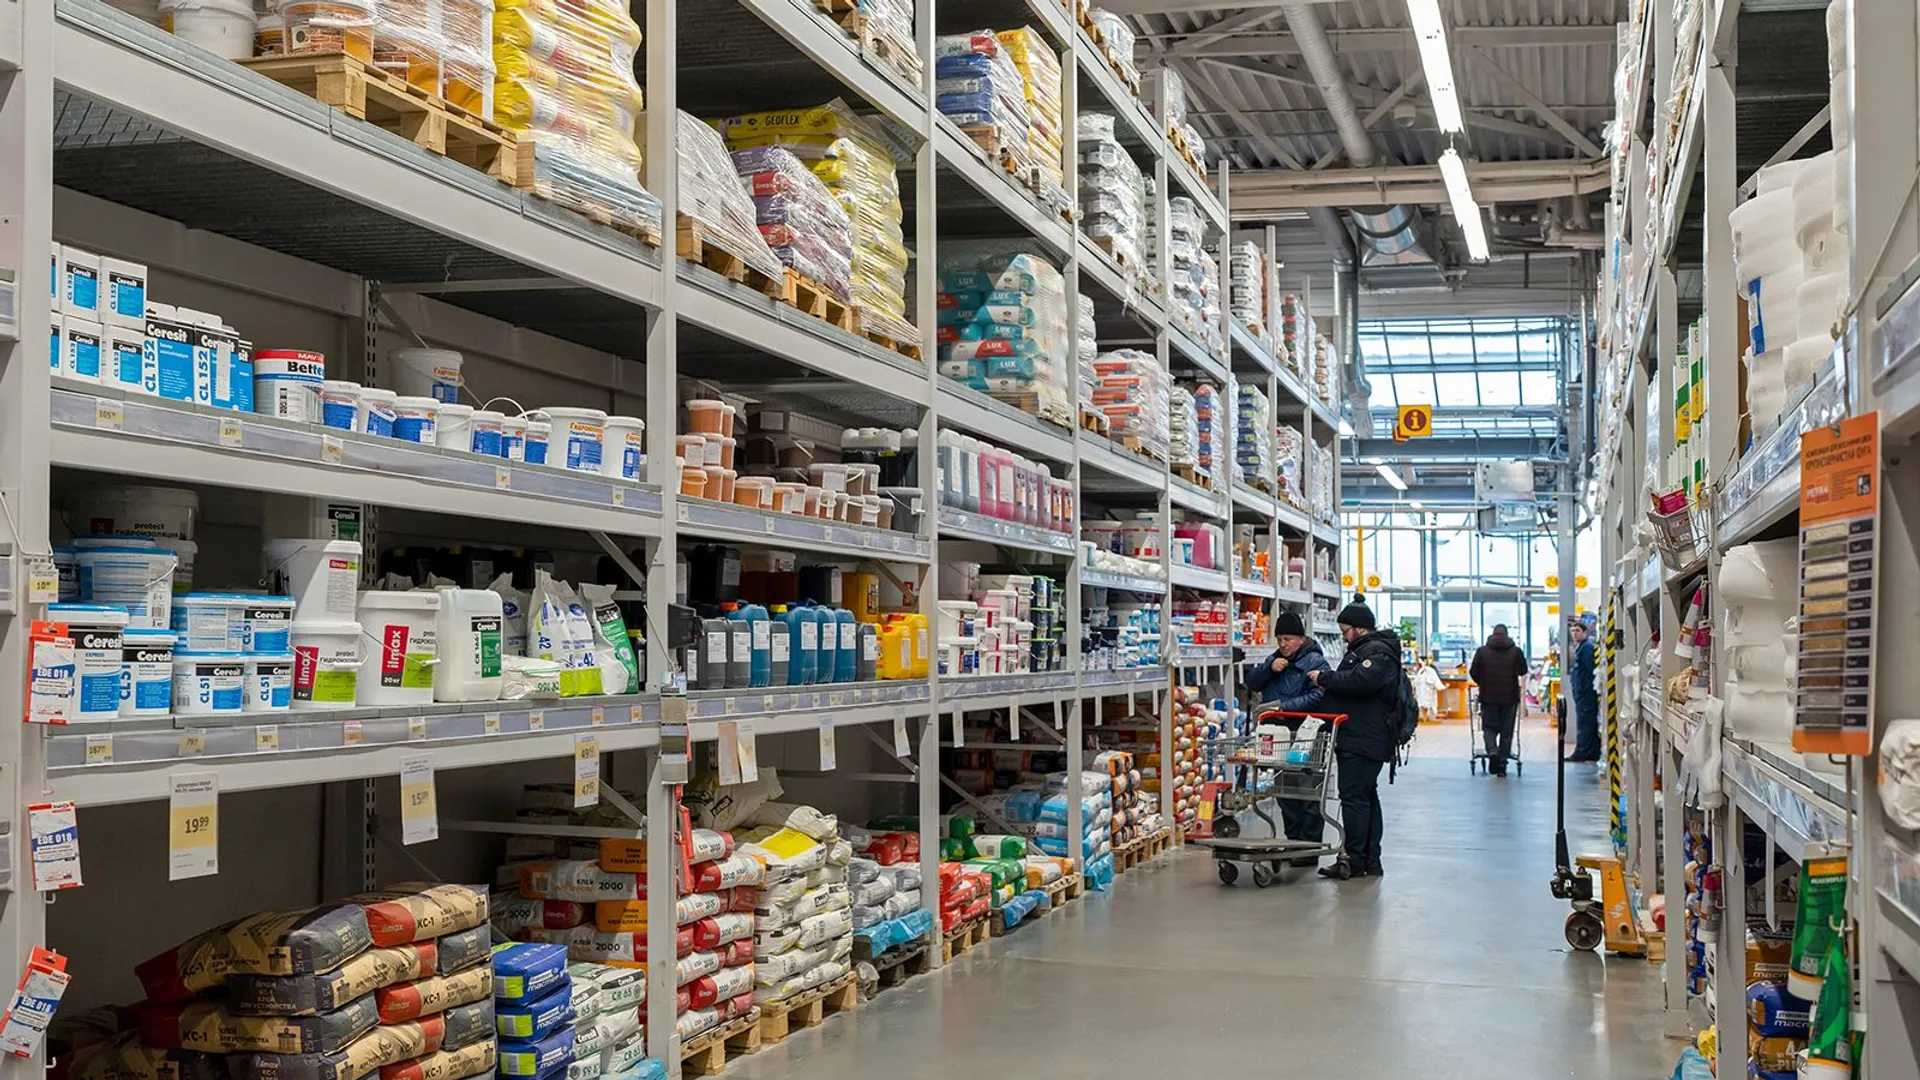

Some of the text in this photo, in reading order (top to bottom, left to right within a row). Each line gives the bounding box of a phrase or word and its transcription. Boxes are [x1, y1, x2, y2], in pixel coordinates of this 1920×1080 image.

[765, 115, 800, 126] GEOFLEX
[116, 276, 138, 287] Ceresit
[146, 324, 188, 342] Ceresit
[144, 339, 156, 392] CL 152
[287, 361, 325, 374] Bette
[198, 350, 209, 401] CL 152
[254, 611, 285, 620] Ceresit
[477, 621, 497, 631] Ceresit
[387, 630, 402, 669] ilmax
[583, 652, 594, 667] 42
[37, 668, 52, 678] EDE
[298, 650, 311, 685] ilmax
[37, 832, 72, 845] EDE 018
[1607, 871, 1614, 881] 1
[598, 881, 624, 891] 2000
[595, 942, 620, 951] 2000
[622, 987, 632, 997] 65
[21, 996, 36, 1008] EDE
[577, 1027, 598, 1043] Ceresit
